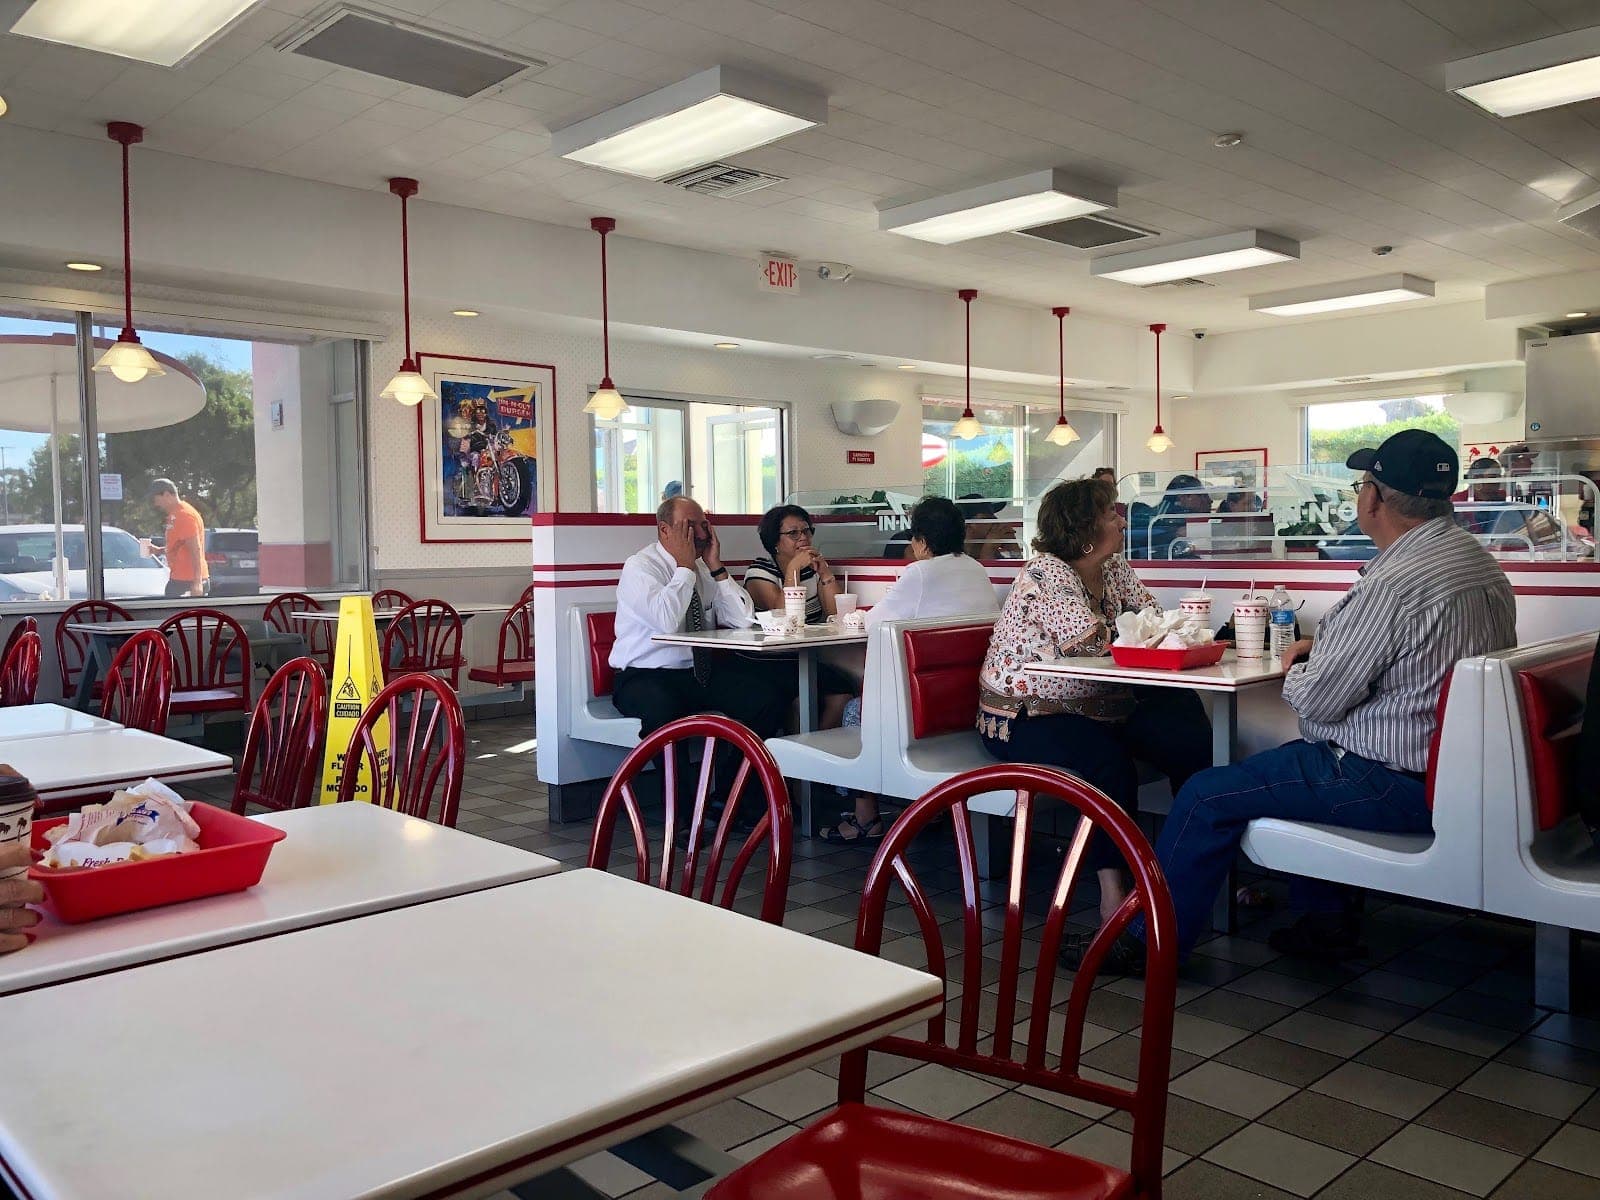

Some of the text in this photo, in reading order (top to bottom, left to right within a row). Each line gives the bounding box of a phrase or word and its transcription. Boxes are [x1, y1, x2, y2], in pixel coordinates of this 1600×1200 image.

[768, 260, 794, 288] EXIT
[878, 515, 912, 531] IN-N
[331, 762, 364, 770] FLR
[326, 784, 368, 793] MODO
